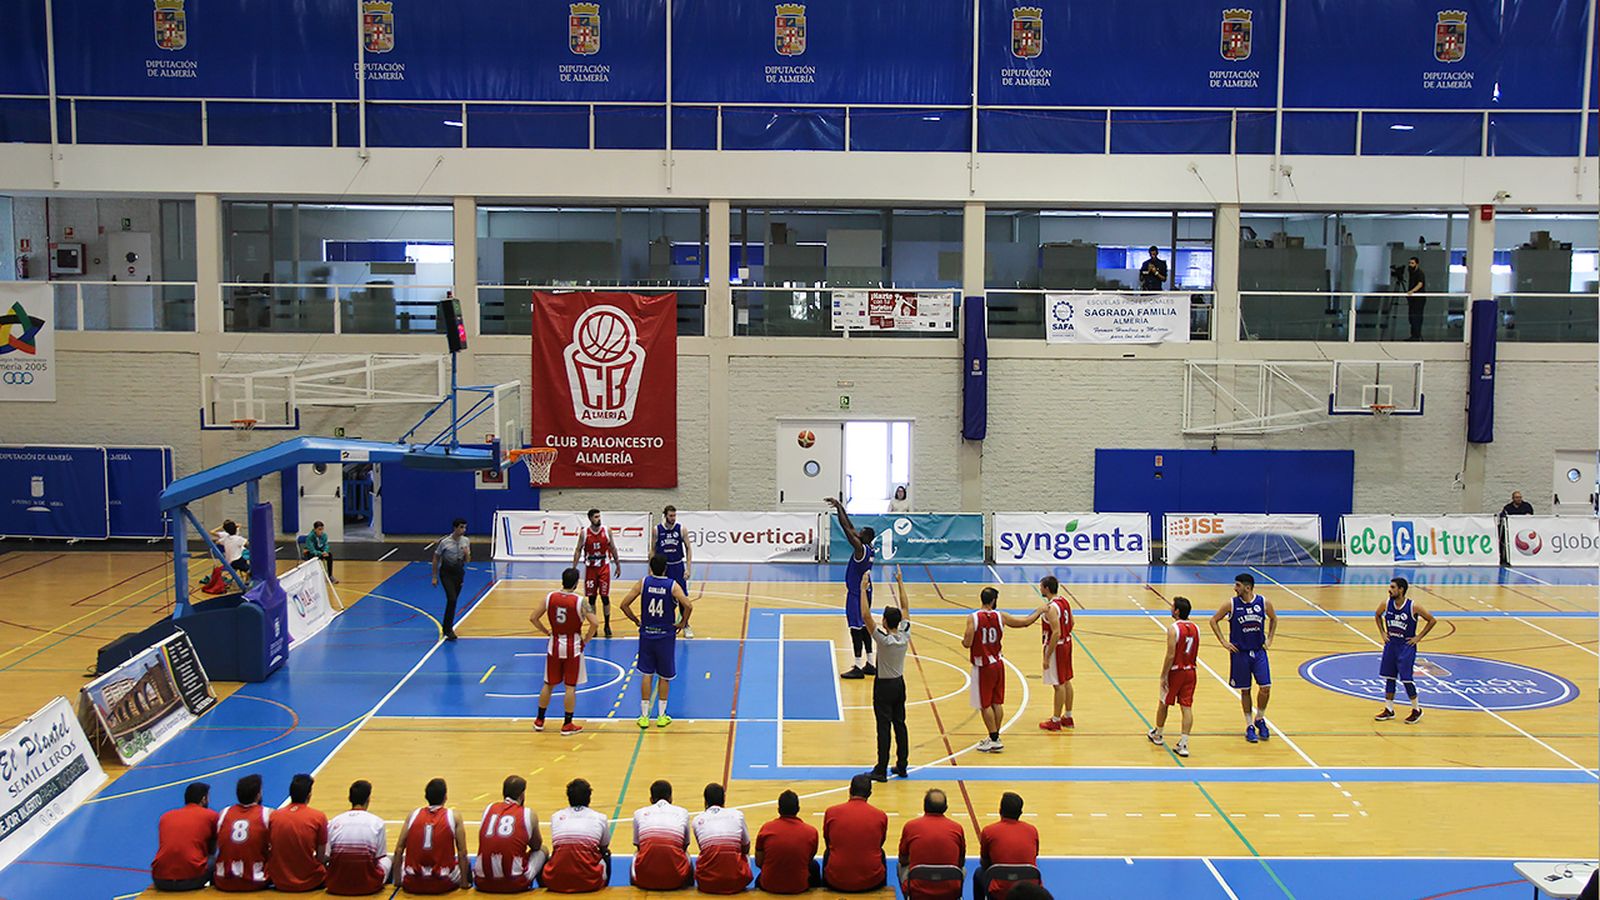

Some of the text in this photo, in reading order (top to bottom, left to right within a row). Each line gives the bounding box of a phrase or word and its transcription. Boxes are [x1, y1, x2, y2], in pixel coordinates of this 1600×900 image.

[145, 59, 198, 69] DIPUTACIÓN
[353, 62, 405, 71] DPUTACIÓN
[559, 63, 610, 73] DIPUTACIÓN
[147, 68, 197, 78] DE ALMERÍA
[764, 65, 816, 74] DIPUTACIÓN
[1001, 67, 1052, 77] DIPUTACIÓN
[1209, 69, 1260, 79] DIPUTACIÓN
[368, 71, 404, 80] ALMERÍA
[560, 73, 609, 82] DE ALMERÍA
[766, 74, 814, 83] DE ALMERÍA
[1423, 71, 1475, 80] DIPUTACIÓN
[1002, 77, 1051, 86] DE ALMERÍA
[1210, 78, 1258, 88] DE ALMERÍA
[1424, 80, 1472, 89] DE ALMERÍA
[1084, 308, 1177, 317] SAGRADA FAMILIA
[1052, 323, 1075, 331] SAFA
[25, 362, 48, 371] 2005
[545, 434, 664, 449] CLUB BALONCESTO
[575, 450, 633, 464] ALMERÍA
[575, 470, 634, 478] www.cbalmeria.es
[1191, 518, 1225, 534] ISE
[1000, 527, 1143, 560] syngenta
[586, 580, 595, 588] 15
[647, 597, 665, 618] 44
[555, 606, 568, 624] 5
[981, 626, 998, 645] 10
[1185, 635, 1194, 654] 7
[0, 747, 18, 782] El
[19, 712, 70, 766] Plantel
[8, 739, 77, 799] SEMILLEROS
[0, 811, 21, 835] EJOR
[485, 813, 515, 837] 18
[231, 819, 250, 843] 8
[423, 824, 435, 850] 1
